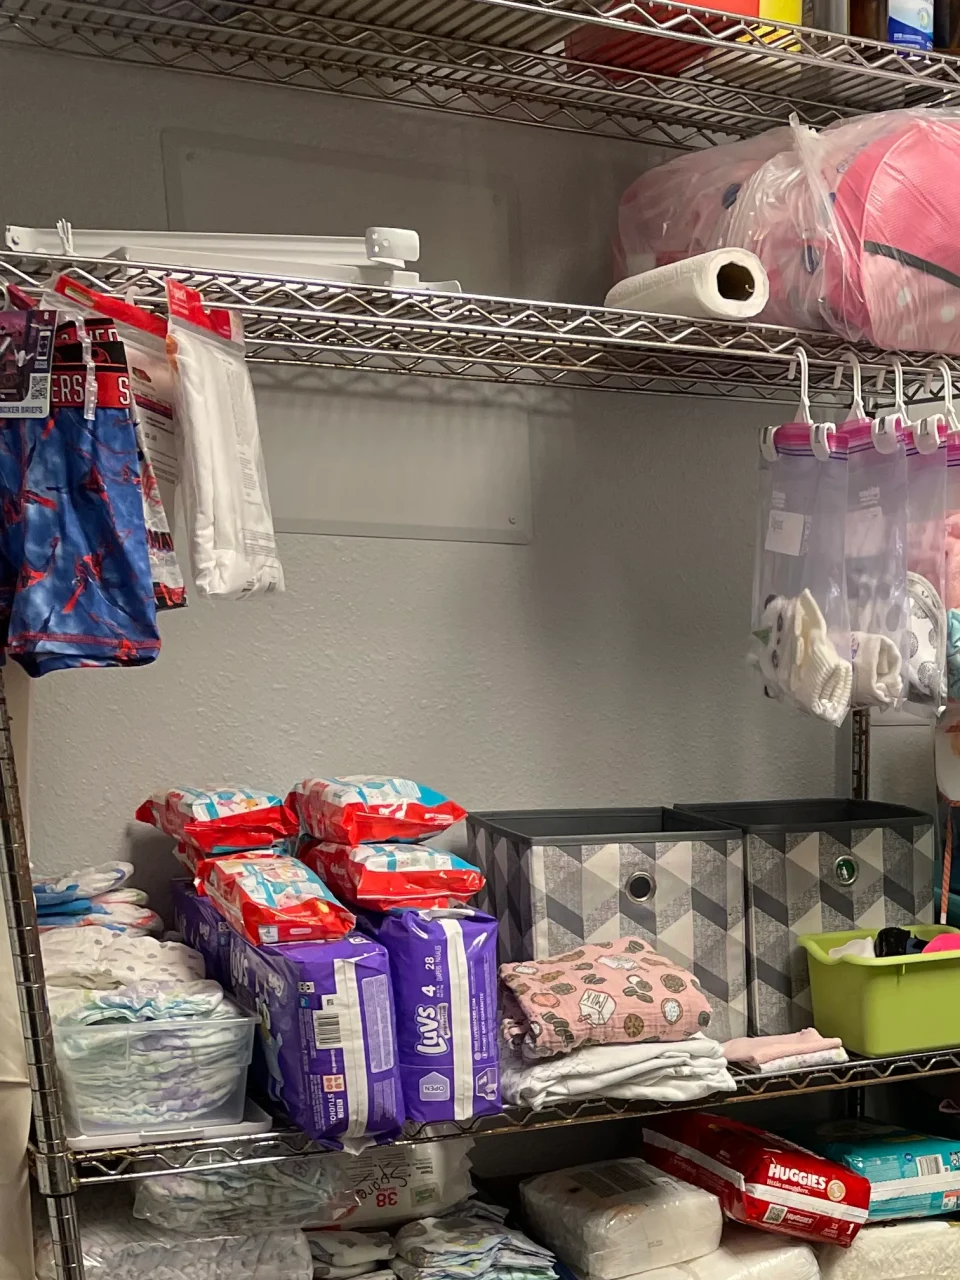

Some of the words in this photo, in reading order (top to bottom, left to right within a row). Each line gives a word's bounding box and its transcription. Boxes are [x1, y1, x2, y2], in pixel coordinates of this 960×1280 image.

[424, 956, 435, 970] 28
[421, 984, 436, 998] 4
[582, 990, 607, 1009] MILK
[416, 1006, 448, 1054] Luvs
[768, 1163, 827, 1190] HUGGIES
[376, 1191, 398, 1208] 38
[846, 1223, 855, 1235] 1
